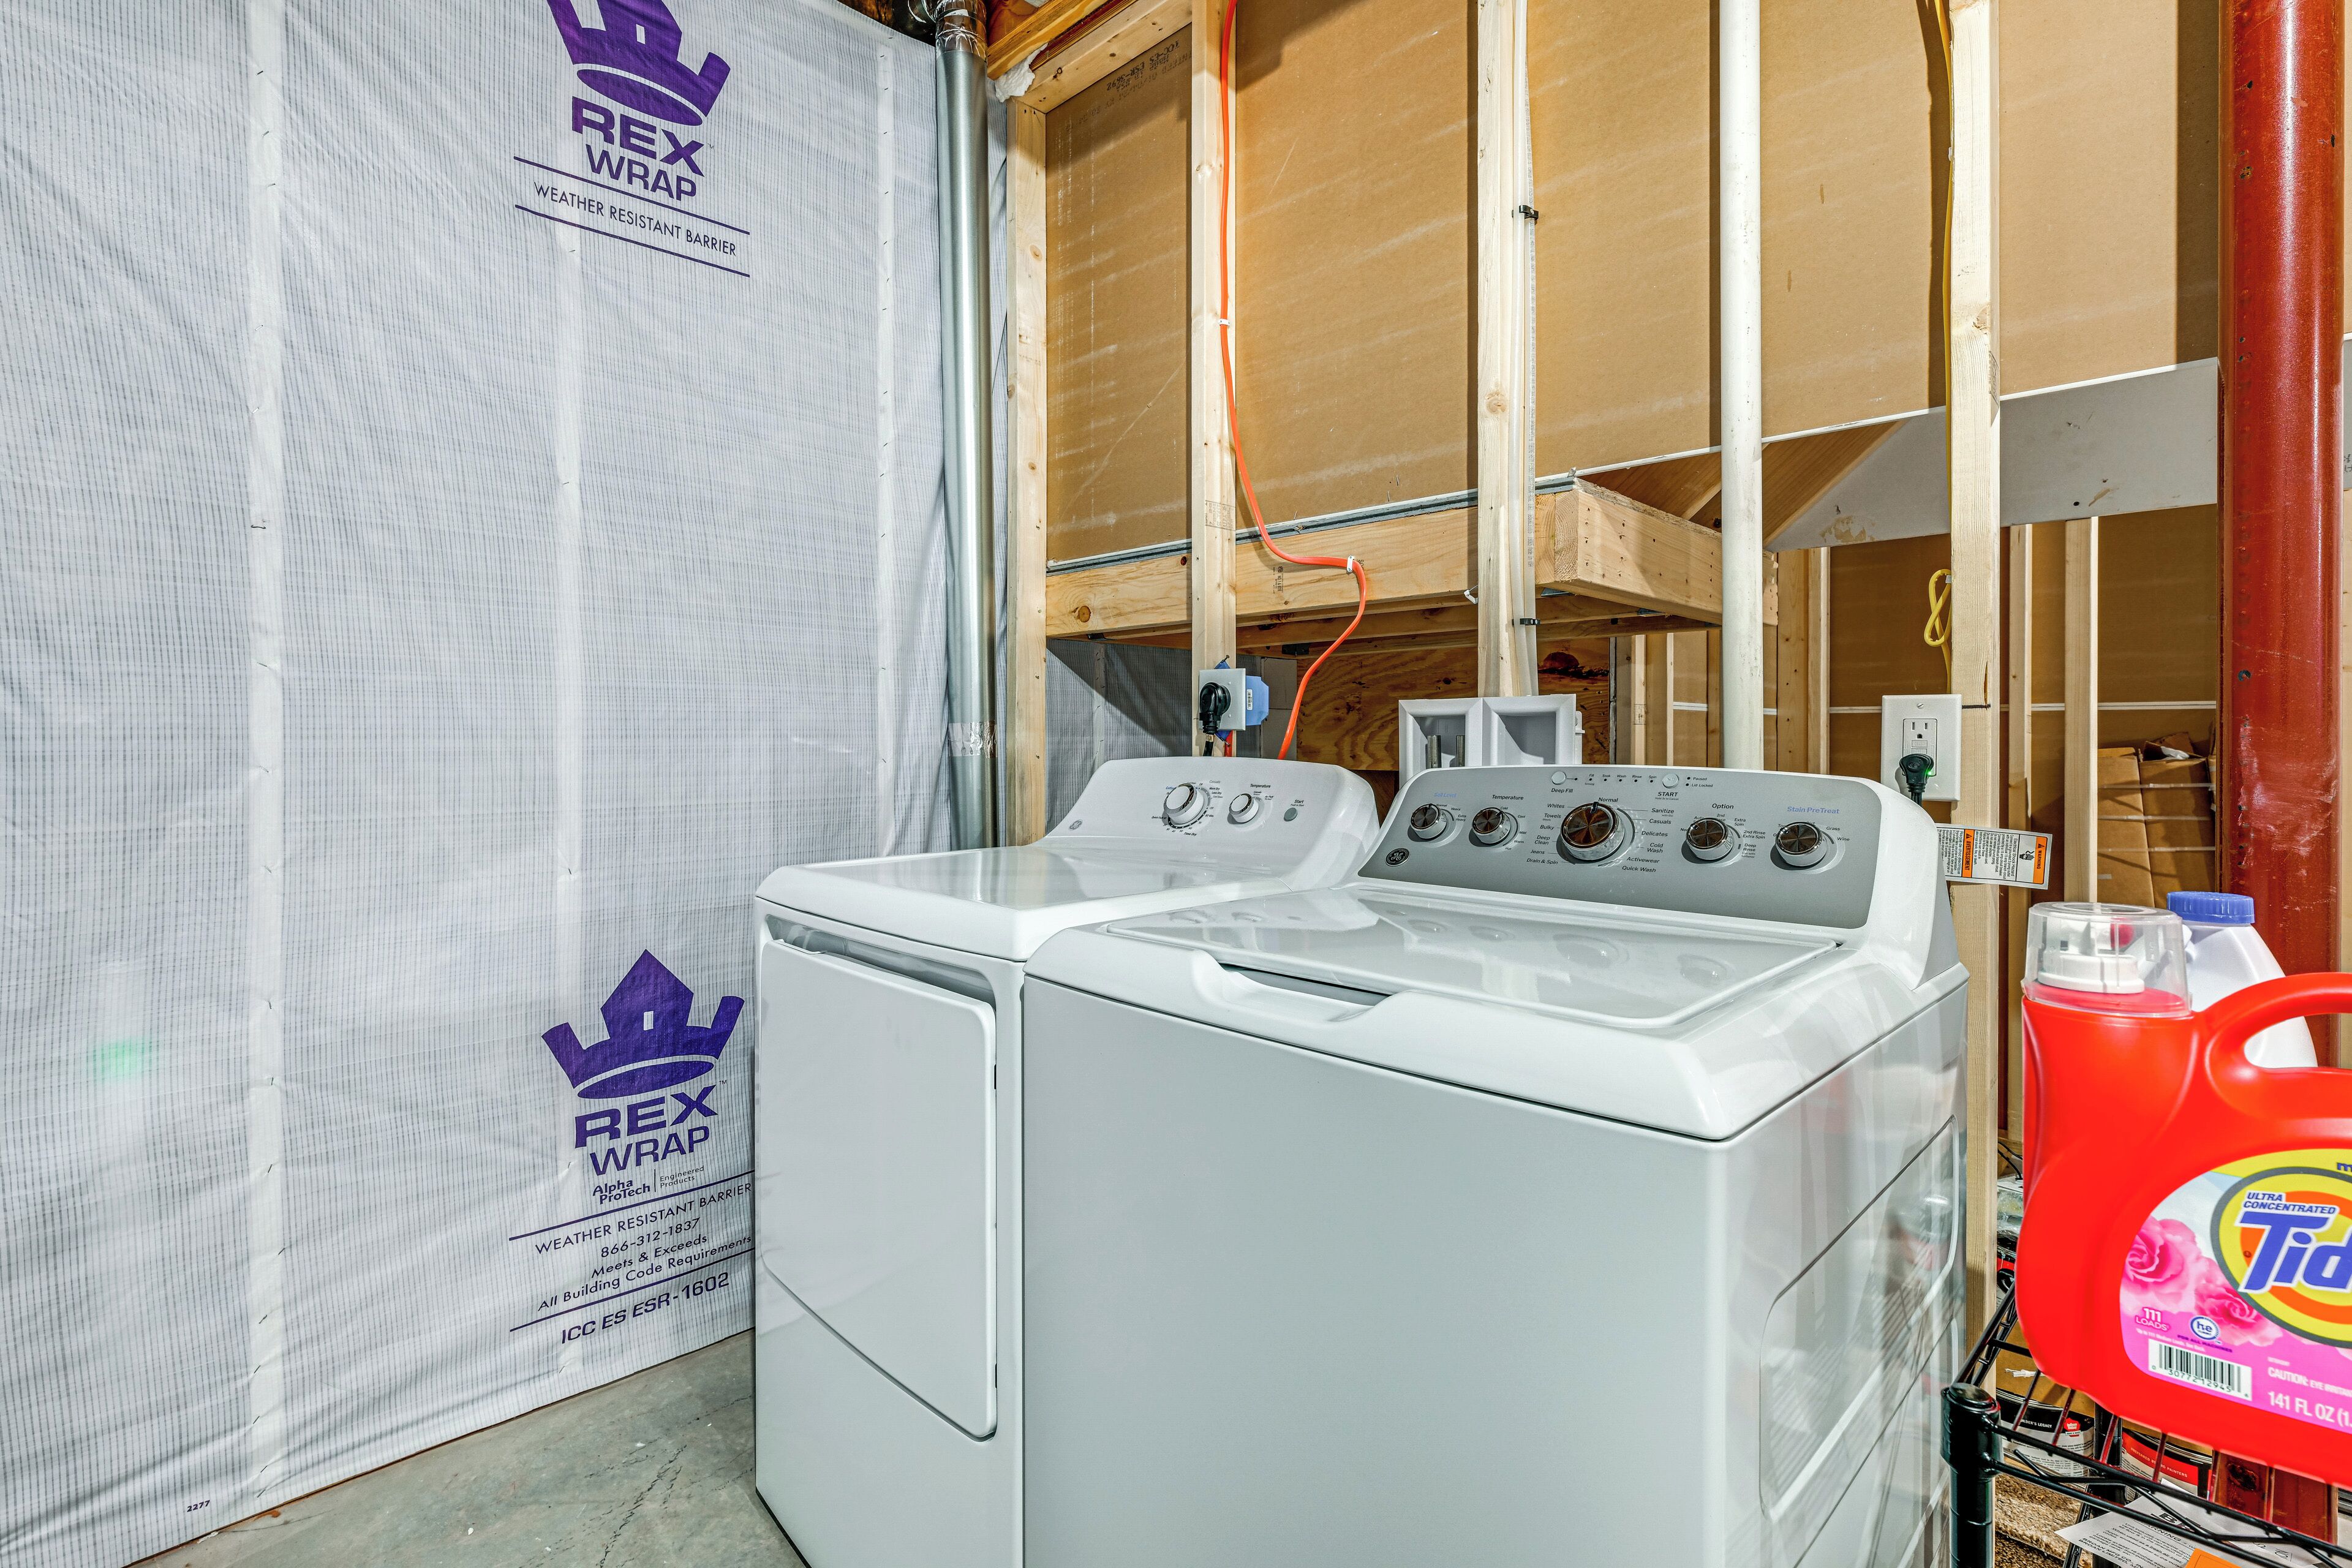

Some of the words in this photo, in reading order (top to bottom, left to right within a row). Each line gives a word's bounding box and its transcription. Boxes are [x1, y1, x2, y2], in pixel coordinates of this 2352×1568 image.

[572, 96, 704, 177] REX
[586, 144, 696, 201] WRAP
[534, 182, 604, 216] WEATHER
[610, 205, 681, 239] RESISTANT
[686, 229, 736, 257] BARRIER
[575, 1085, 718, 1148] REX
[590, 1126, 710, 1176] WRAP
[593, 1180, 633, 1196] Alpha
[660, 1166, 704, 1182] Engineered
[660, 1175, 695, 1188] Products
[600, 1183, 650, 1205] ProTech
[2244, 1201, 2335, 1214] CONCENTRATED
[2247, 1192, 2283, 1201] ULTRA
[536, 1225, 611, 1255] WEATHER
[617, 1200, 695, 1232] RESISTANT
[699, 1183, 751, 1207] BARRIER
[601, 1217, 701, 1257] 866-312-1837
[538, 1296, 558, 1311] All
[563, 1278, 620, 1301] Building
[626, 1263, 662, 1281] Code
[668, 1235, 751, 1268] Requirements
[592, 1259, 633, 1278] Meets
[639, 1253, 649, 1262] &
[654, 1234, 707, 1257] Exceeds
[562, 1323, 595, 1344] ICC
[601, 1310, 627, 1329] ES
[632, 1272, 729, 1318] ESR-1602
[2143, 1308, 2162, 1322] 111
[2267, 1391, 2290, 1410] 141
[2295, 1397, 2313, 1417] FL
[2315, 1403, 2335, 1423] OZ
[2131, 1447, 2150, 1461] PREFERRED
[2167, 1468, 2188, 1477] PAINTERS
[187, 1500, 210, 1512] 2277
